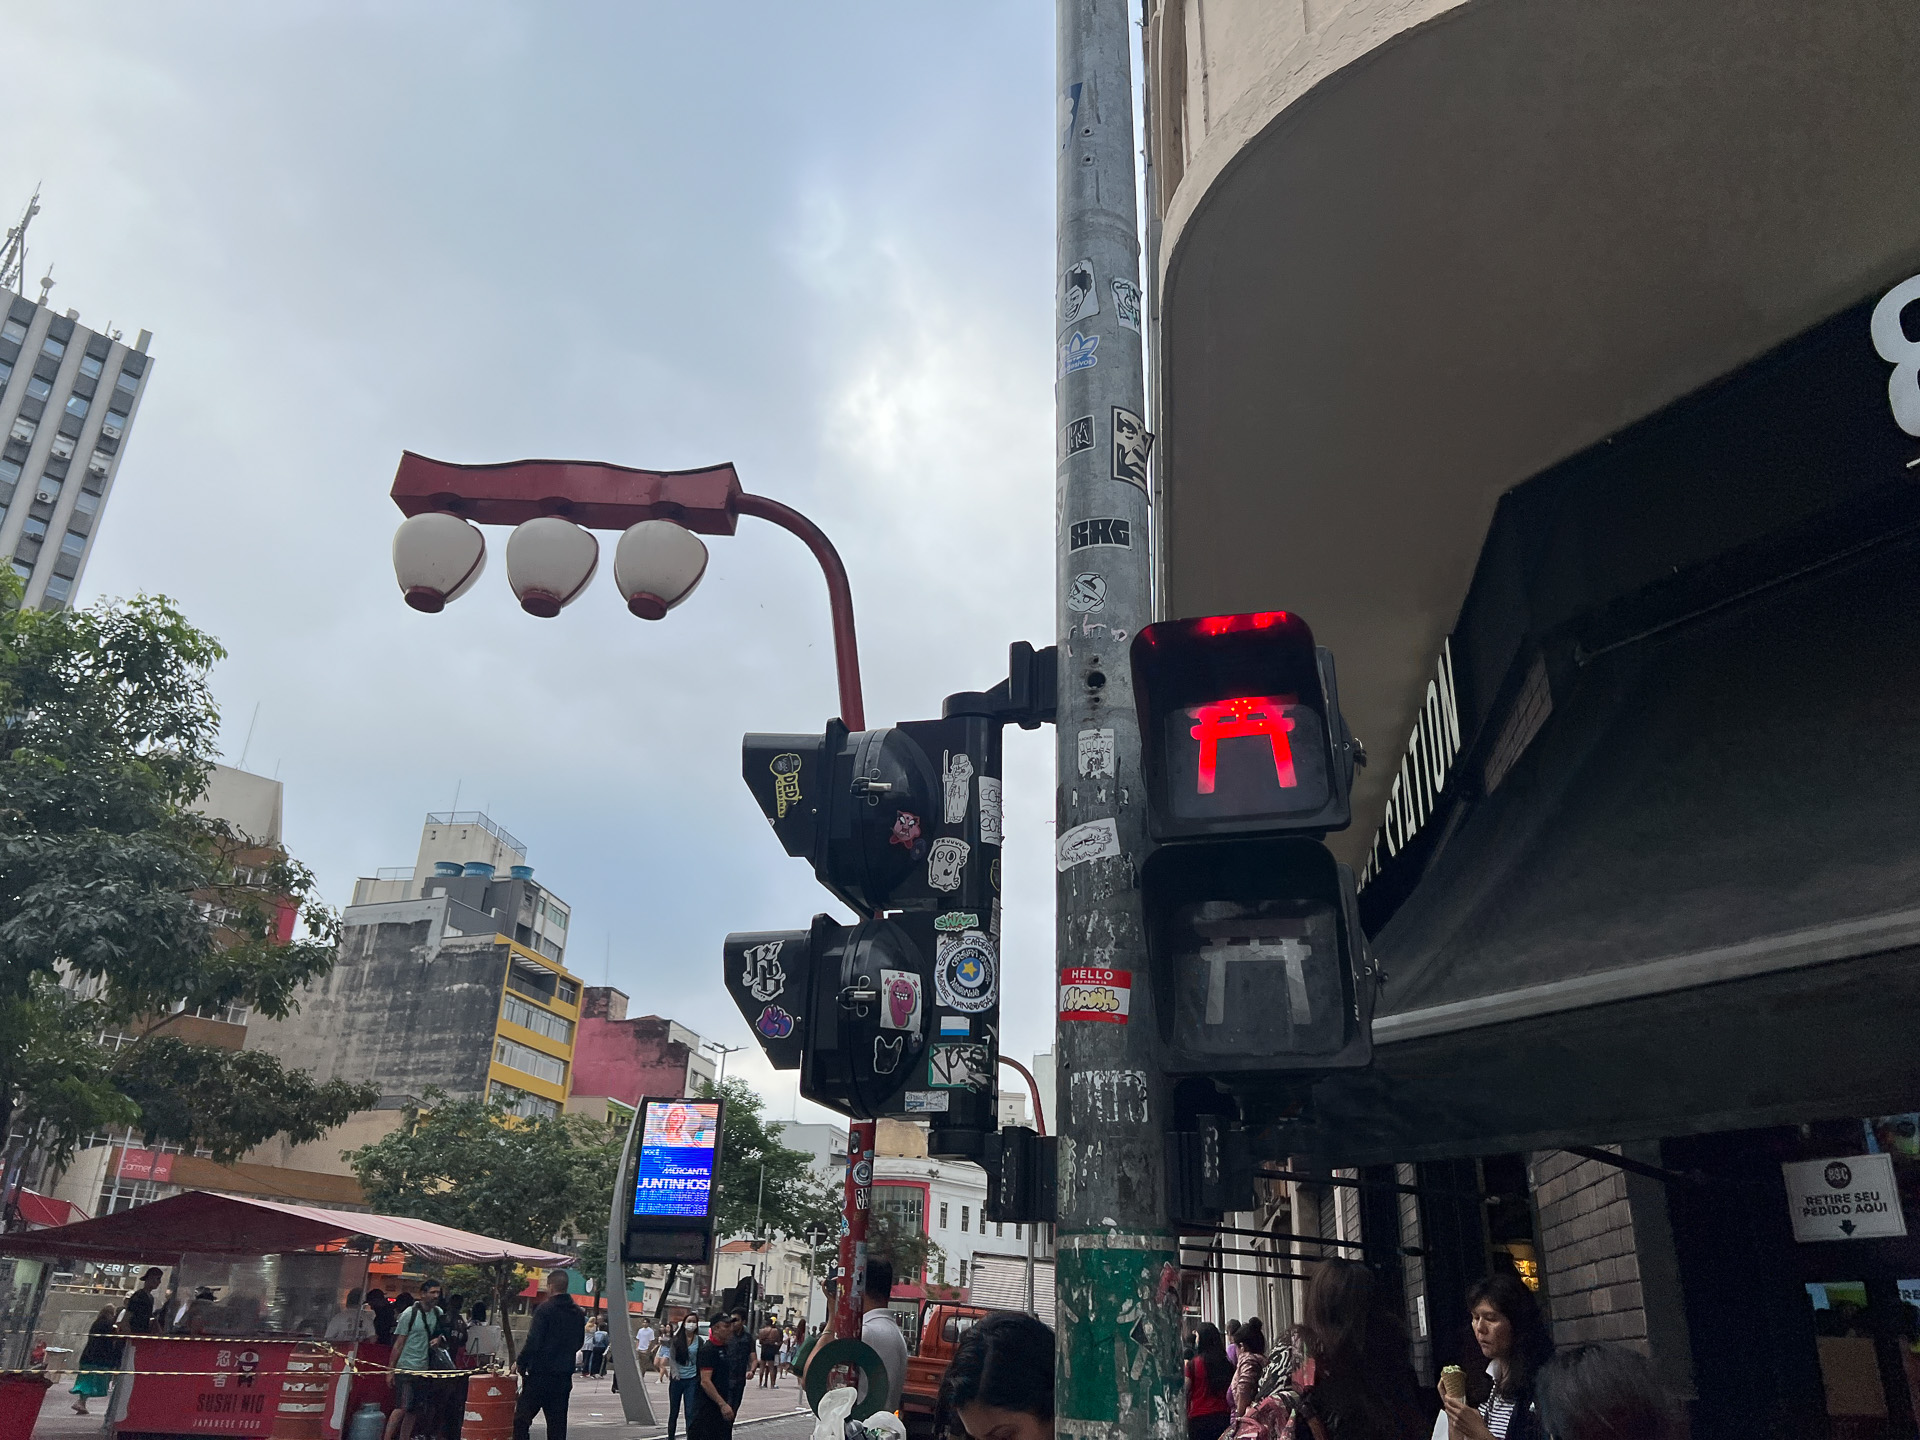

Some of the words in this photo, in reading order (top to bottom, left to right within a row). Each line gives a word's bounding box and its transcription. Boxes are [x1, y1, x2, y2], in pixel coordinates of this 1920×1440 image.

[1386, 636, 1461, 857] STATION
[1071, 970, 1114, 981] HELLO
[661, 1167, 711, 1176] MERCANTIL
[637, 1178, 711, 1190] JUNTINHOS!
[1806, 1193, 1852, 1206] RETIRE
[1854, 1191, 1880, 1203] SEU
[1803, 1205, 1852, 1218] PEDIDO
[1855, 1202, 1888, 1214] AQUI
[197, 1393, 237, 1413] SUSHI
[192, 1418, 236, 1429] JAPANESE
[238, 1420, 261, 1430] FOOD
